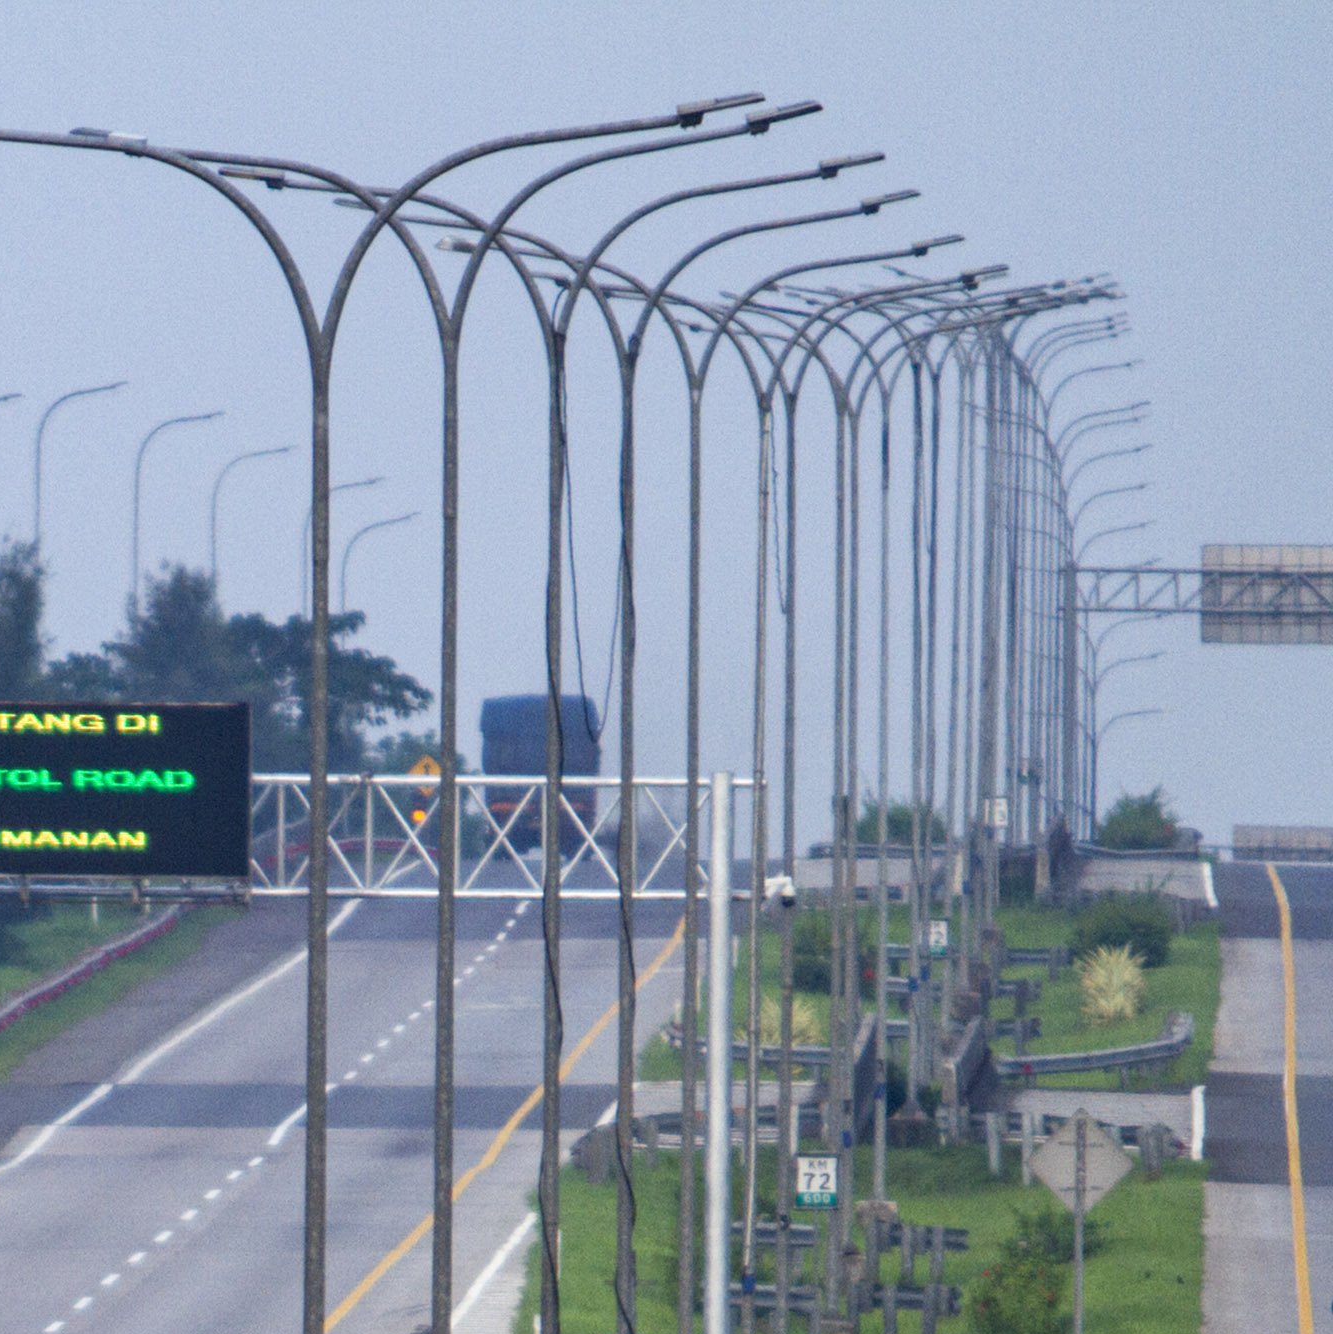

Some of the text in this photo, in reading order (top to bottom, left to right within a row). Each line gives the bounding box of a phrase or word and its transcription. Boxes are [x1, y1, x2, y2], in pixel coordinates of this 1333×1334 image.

[116, 714, 160, 735] DI
[72, 769, 197, 792] ROAD
[803, 1172, 831, 1190] 72
